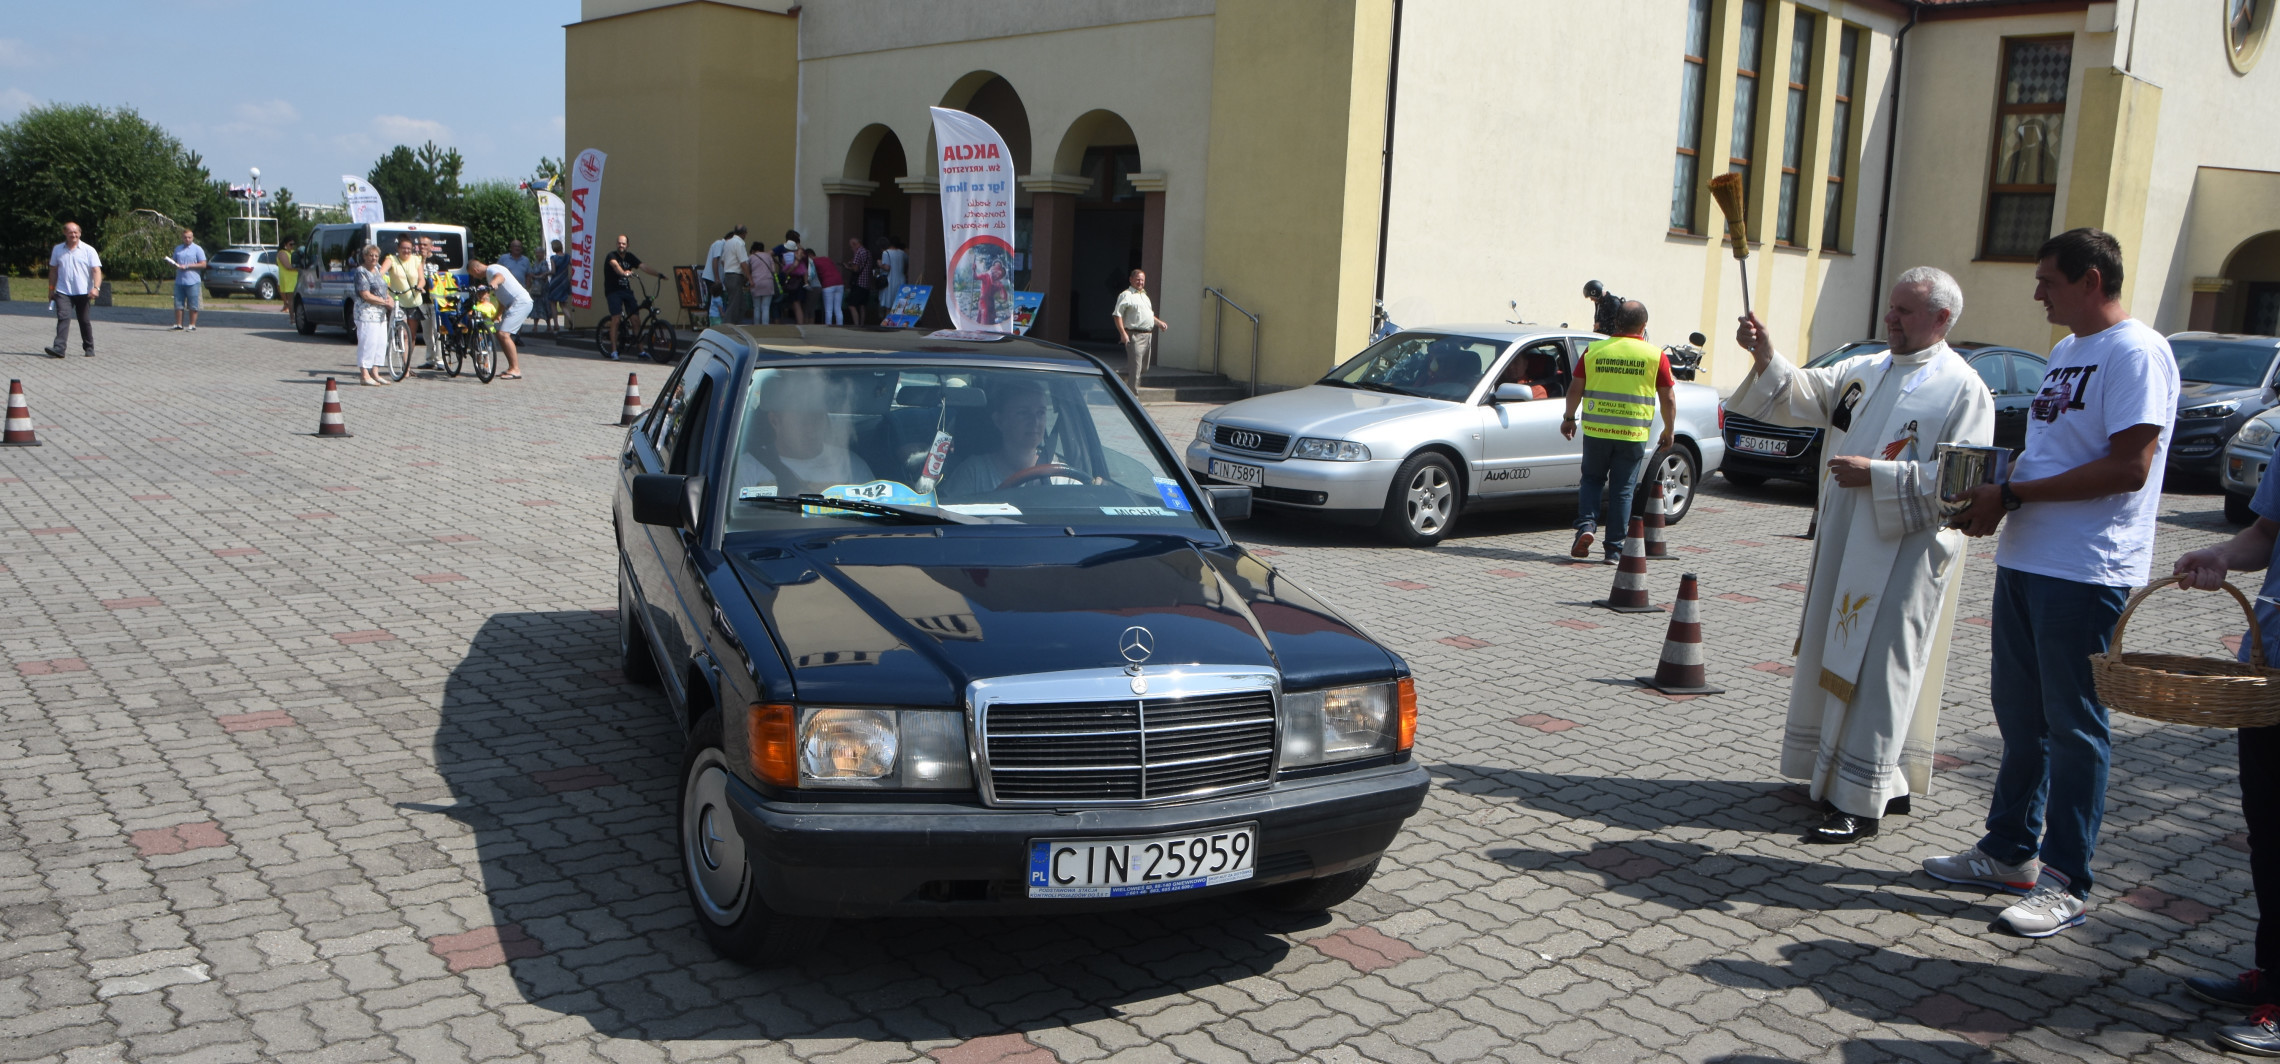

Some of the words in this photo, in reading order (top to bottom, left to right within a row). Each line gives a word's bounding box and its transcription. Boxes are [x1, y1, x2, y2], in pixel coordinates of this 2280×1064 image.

[580, 234, 593, 290] Polska
[1595, 358, 1645, 368] AUTOMOBILKLUB
[1595, 366, 1645, 376] INOWROCŁAWSKI
[1740, 436, 1757, 449] FSD
[1759, 439, 1787, 453] 61142
[1214, 461, 1230, 478] CIN
[1232, 464, 1261, 483] 75891
[1484, 469, 1509, 481] Audi
[852, 484, 887, 498] 142
[1053, 845, 1131, 885] CIN
[1142, 832, 1250, 881] 25959
[1032, 871, 1046, 882] PL
